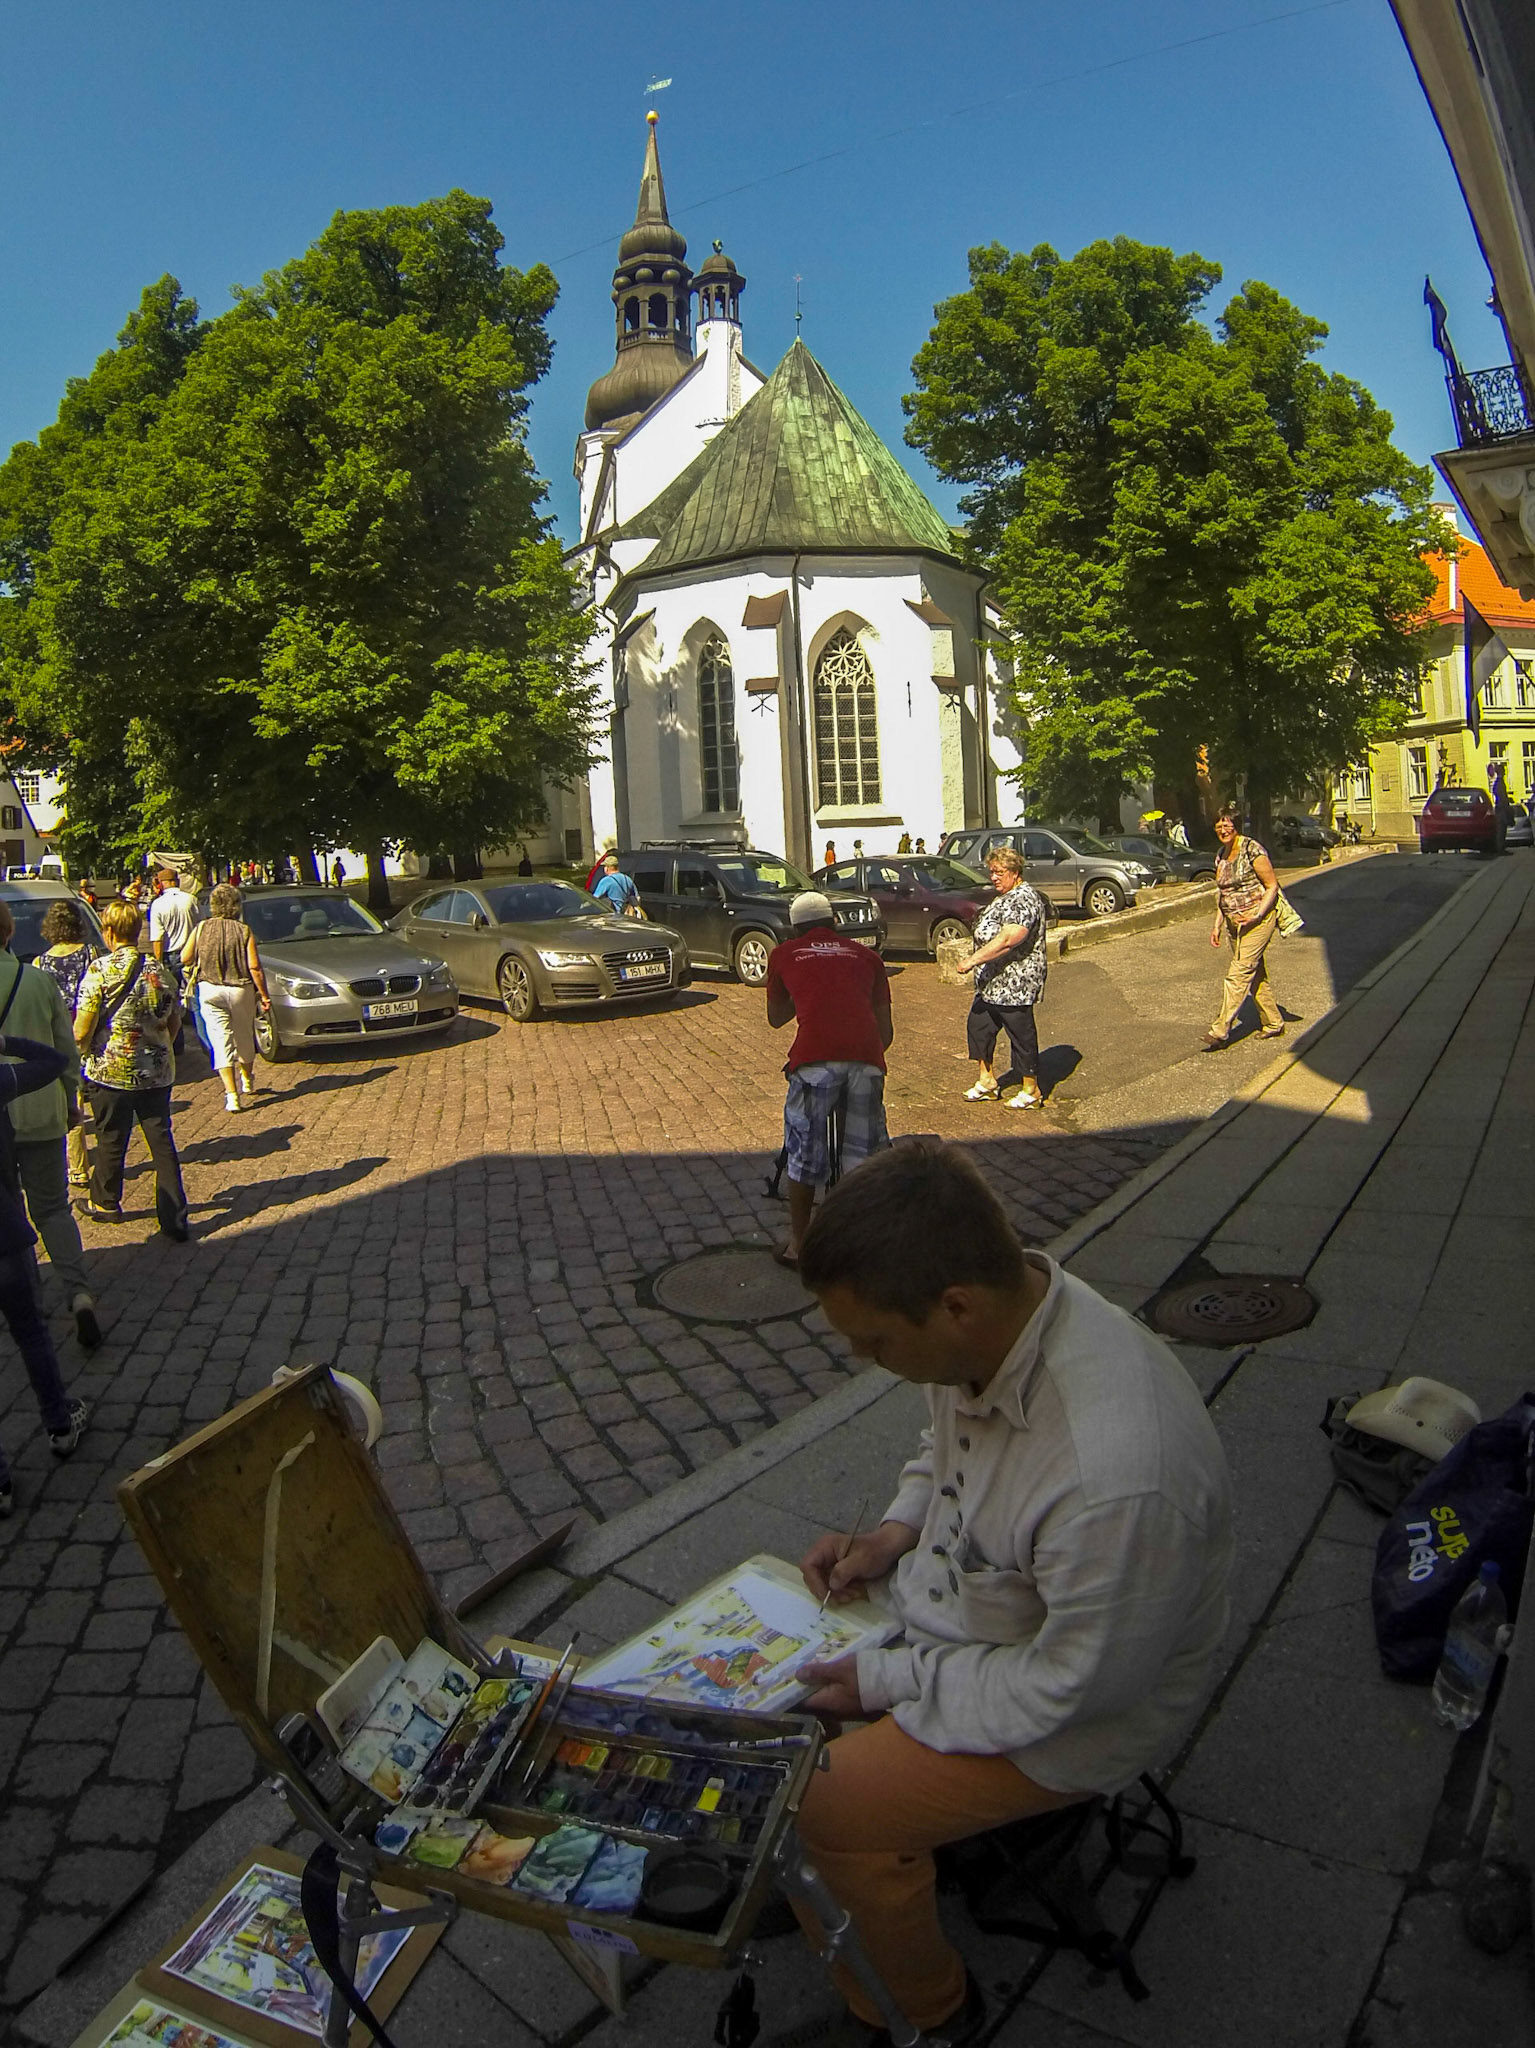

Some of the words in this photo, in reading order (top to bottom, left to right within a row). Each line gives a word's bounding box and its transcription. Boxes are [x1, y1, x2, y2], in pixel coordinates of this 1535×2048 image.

[810, 941, 840, 949] OPS
[629, 967, 642, 977] 151
[372, 1004, 391, 1016] 768
[393, 1001, 415, 1014] MEU
